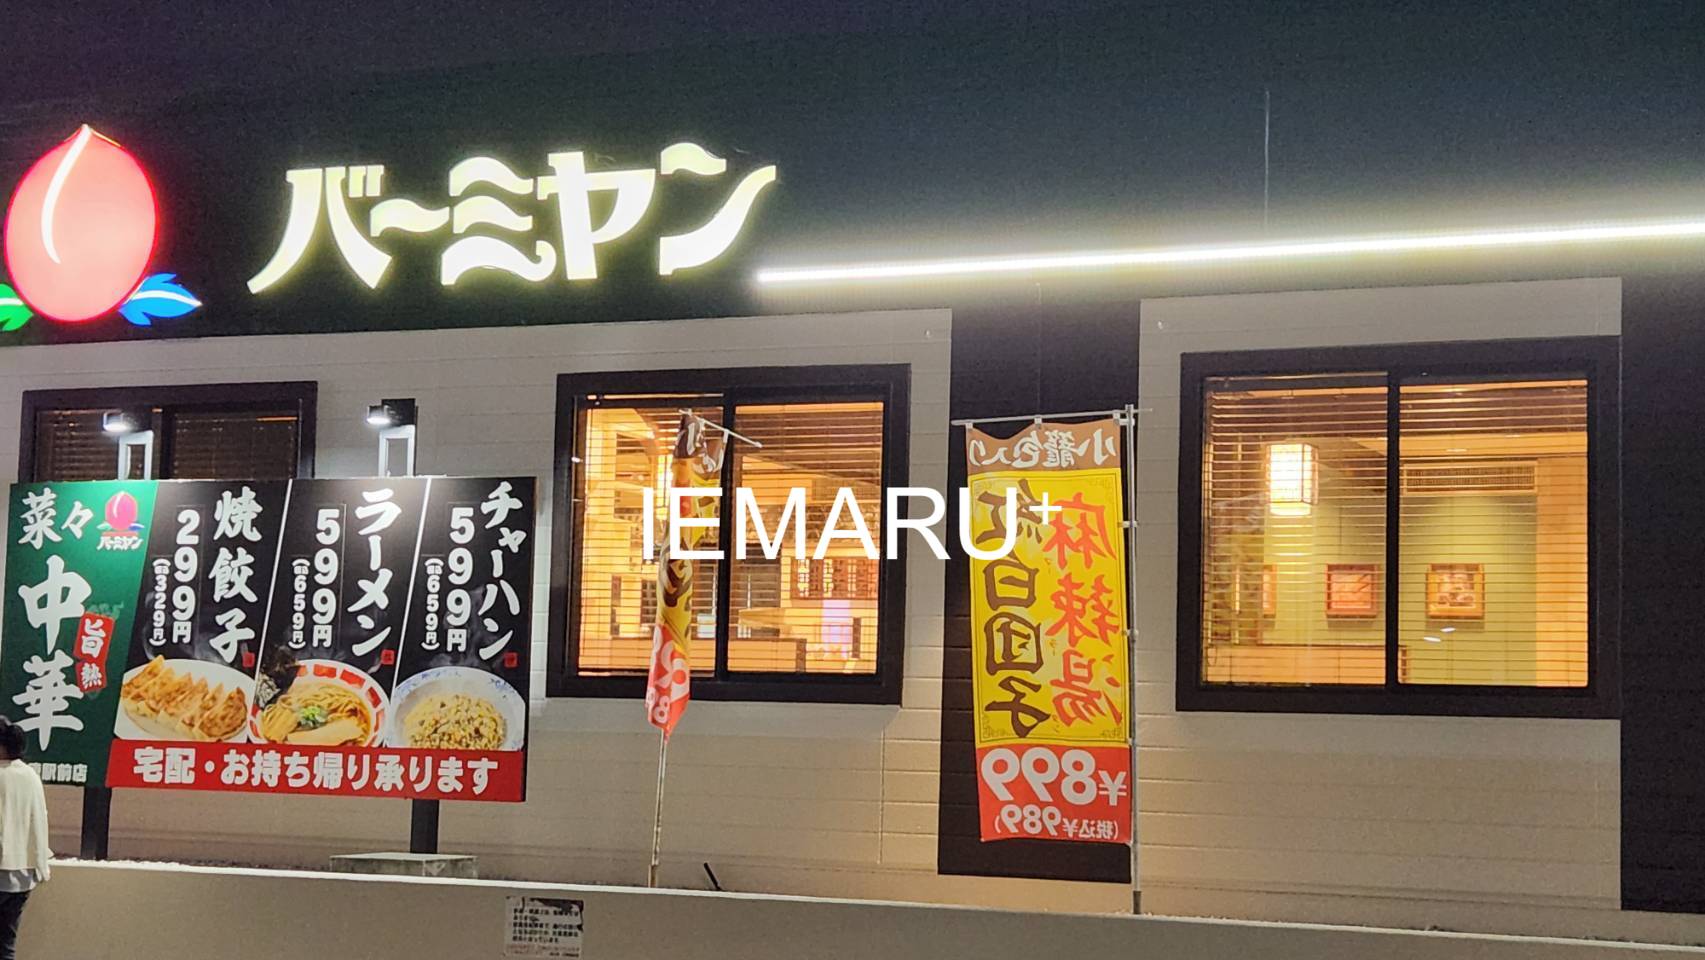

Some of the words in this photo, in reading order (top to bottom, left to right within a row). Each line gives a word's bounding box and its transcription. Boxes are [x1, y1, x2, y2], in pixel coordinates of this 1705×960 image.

[247, 142, 777, 295] バーミヤン
[19, 487, 94, 551] 菜々
[172, 508, 201, 644] 299円
[208, 485, 263, 665] 焼餃子
[312, 508, 340, 649] 599円
[347, 487, 403, 657] ラーメン
[446, 507, 476, 653] 599円
[478, 480, 527, 661] チャーハン
[12, 555, 93, 752] 中華
[133, 746, 499, 795] 宅配・お持ち帰り承ります
